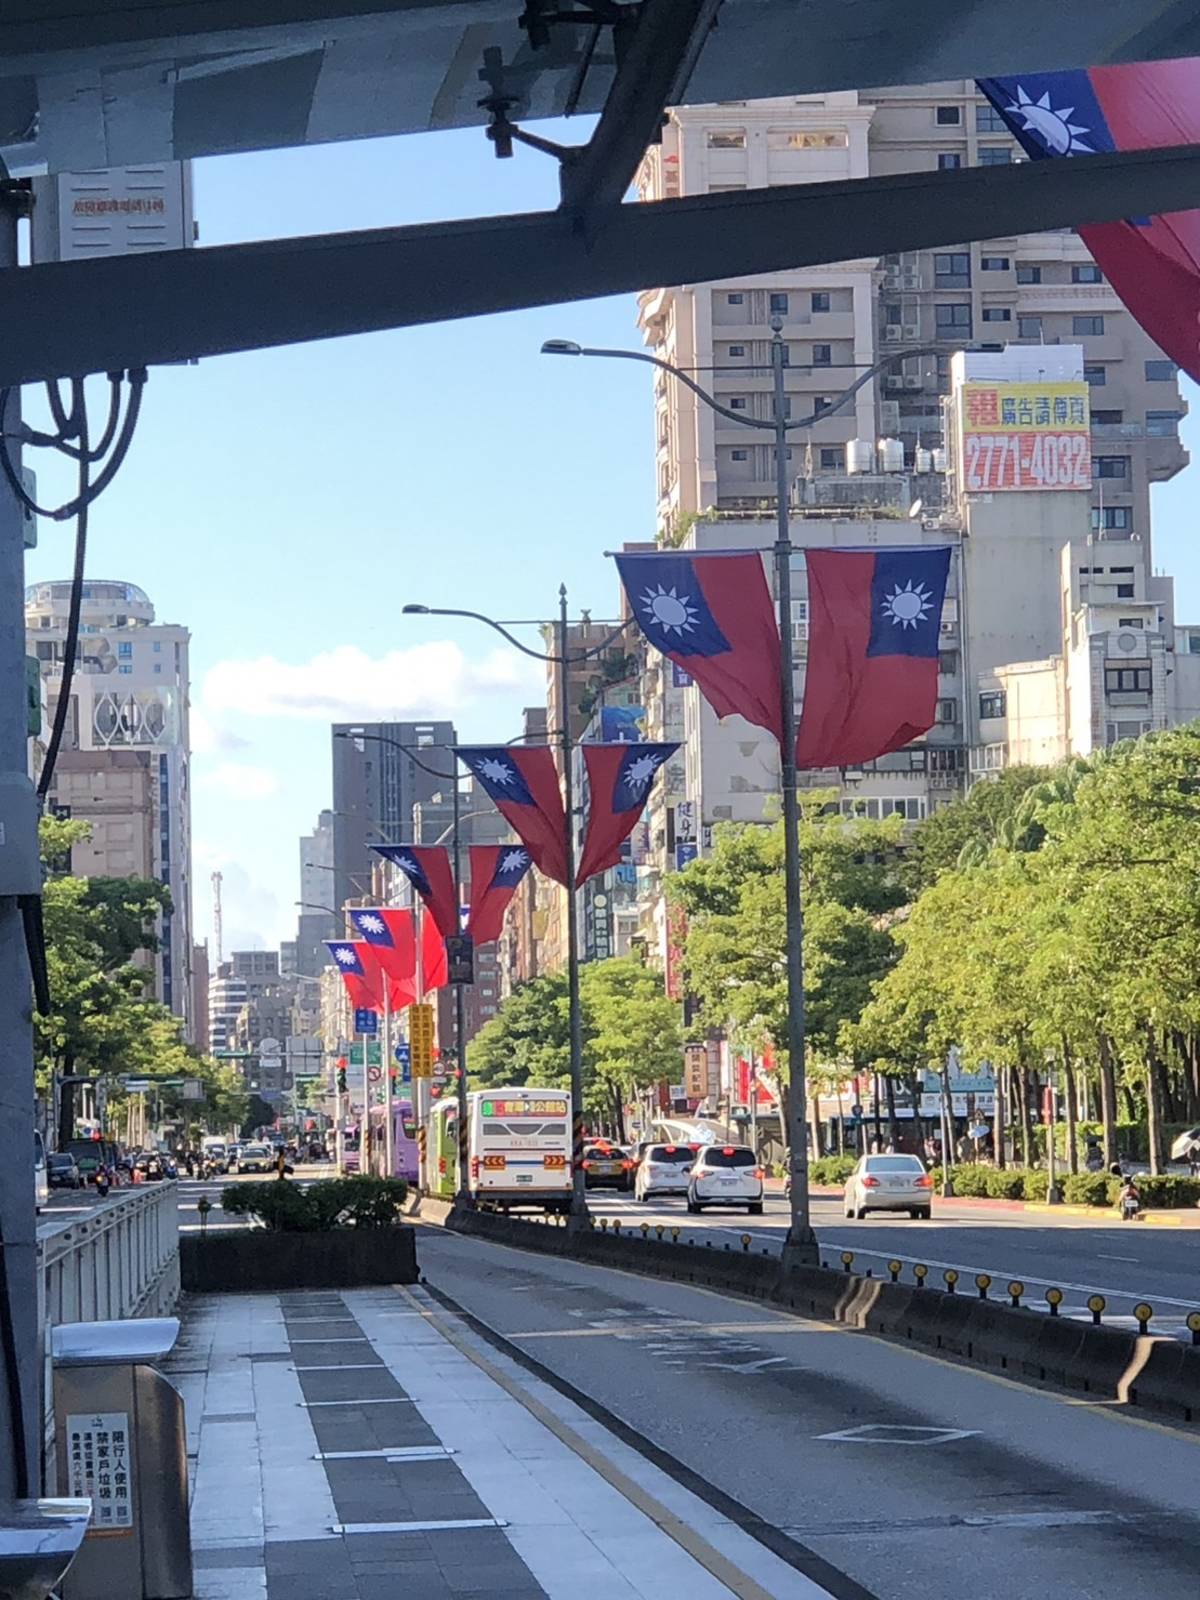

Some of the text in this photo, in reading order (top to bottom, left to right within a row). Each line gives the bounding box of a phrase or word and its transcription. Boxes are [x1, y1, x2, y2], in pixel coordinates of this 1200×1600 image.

[967, 435, 1087, 487] 2771-4032
[96, 1431, 112, 1499] 禁家戶垃圾
[112, 1430, 128, 1498] 限行人使用
